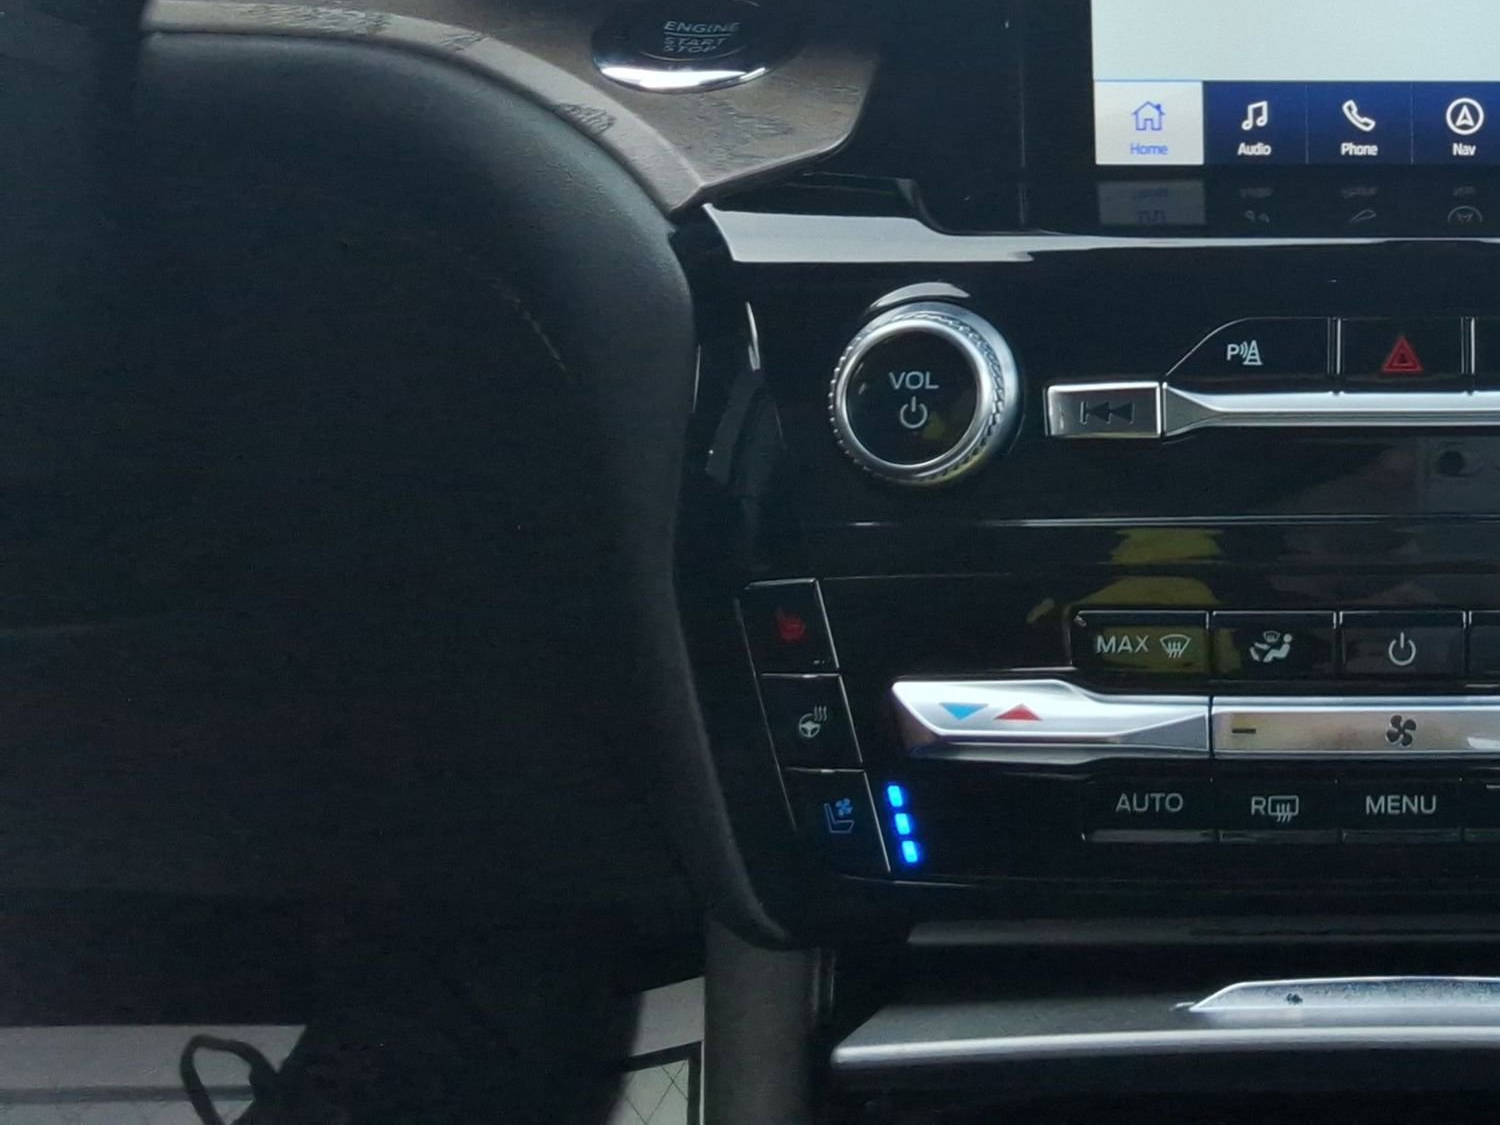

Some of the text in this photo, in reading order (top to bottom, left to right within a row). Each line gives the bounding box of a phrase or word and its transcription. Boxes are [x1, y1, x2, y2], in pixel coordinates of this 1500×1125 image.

[663, 21, 742, 34] ENGINE
[663, 37, 728, 47] START
[1129, 143, 1169, 156] Home
[1237, 142, 1273, 157] Audio
[1340, 142, 1379, 157] Phone
[1452, 143, 1477, 157] Nav
[889, 371, 940, 391] VOL
[1096, 634, 1150, 654] MAX
[1115, 793, 1184, 813] AUTO
[1365, 794, 1438, 815] MENU
